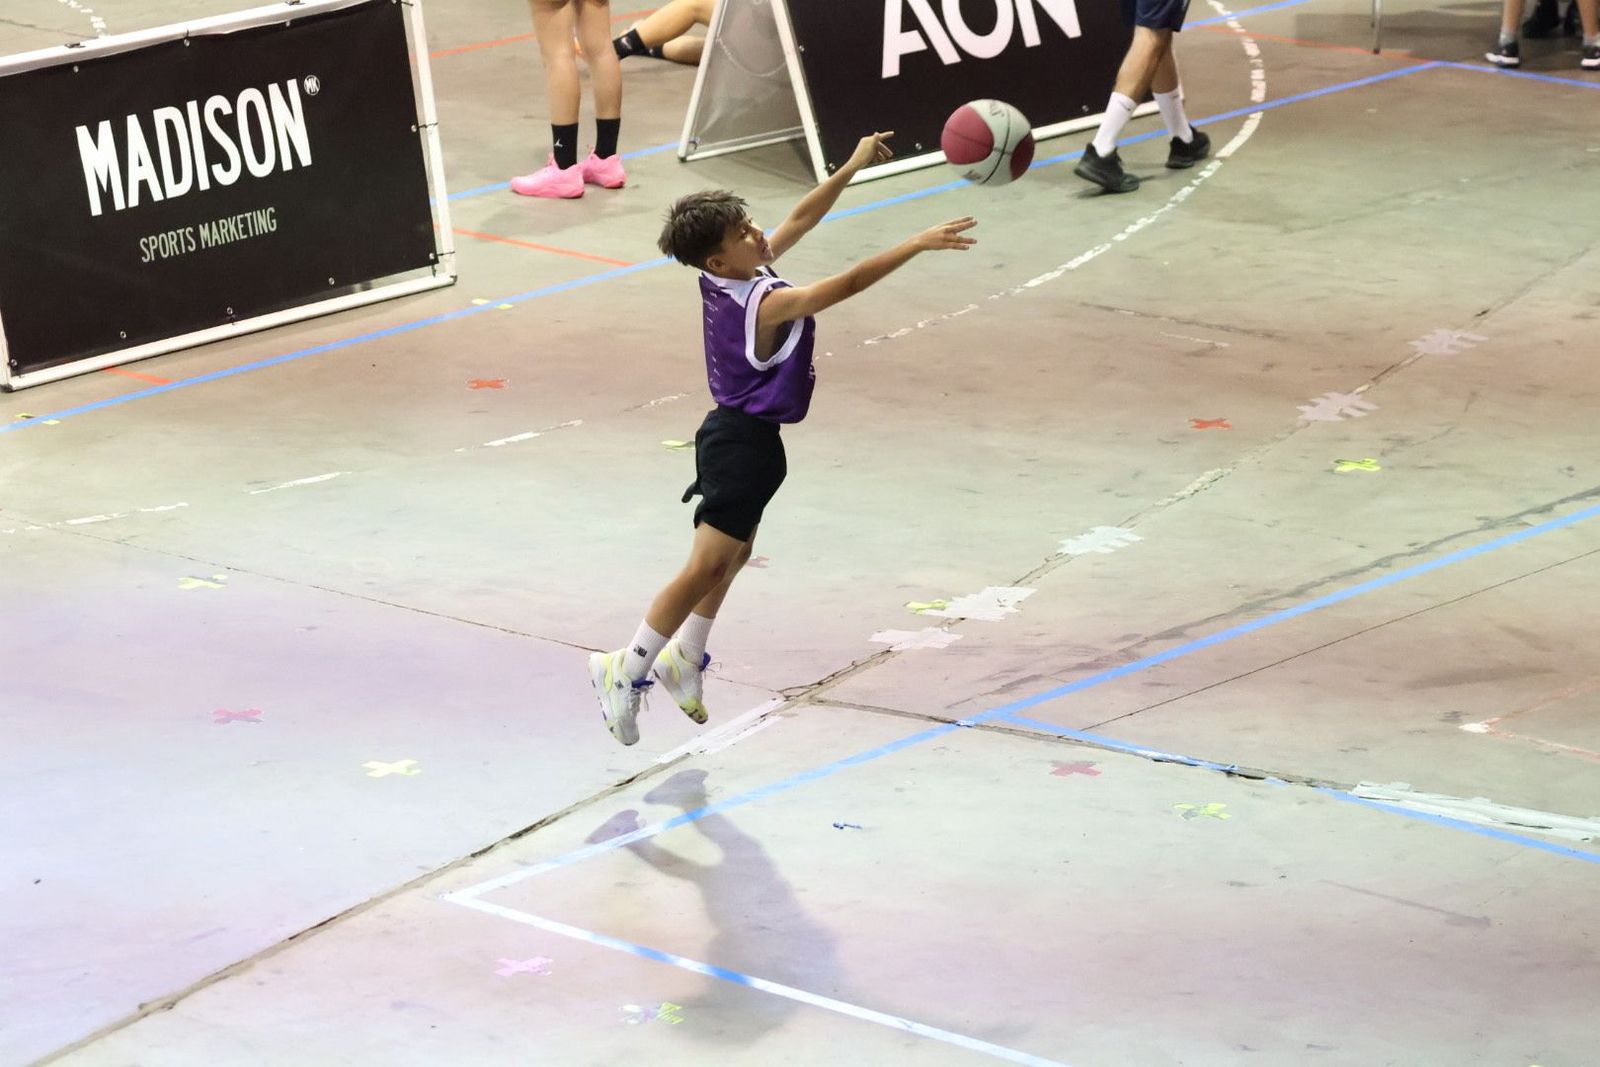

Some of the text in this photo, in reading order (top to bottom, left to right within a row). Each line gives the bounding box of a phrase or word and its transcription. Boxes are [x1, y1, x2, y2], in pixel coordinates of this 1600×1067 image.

[75, 78, 313, 217] MADISON
[139, 206, 277, 263] SPORTS MARKETING
